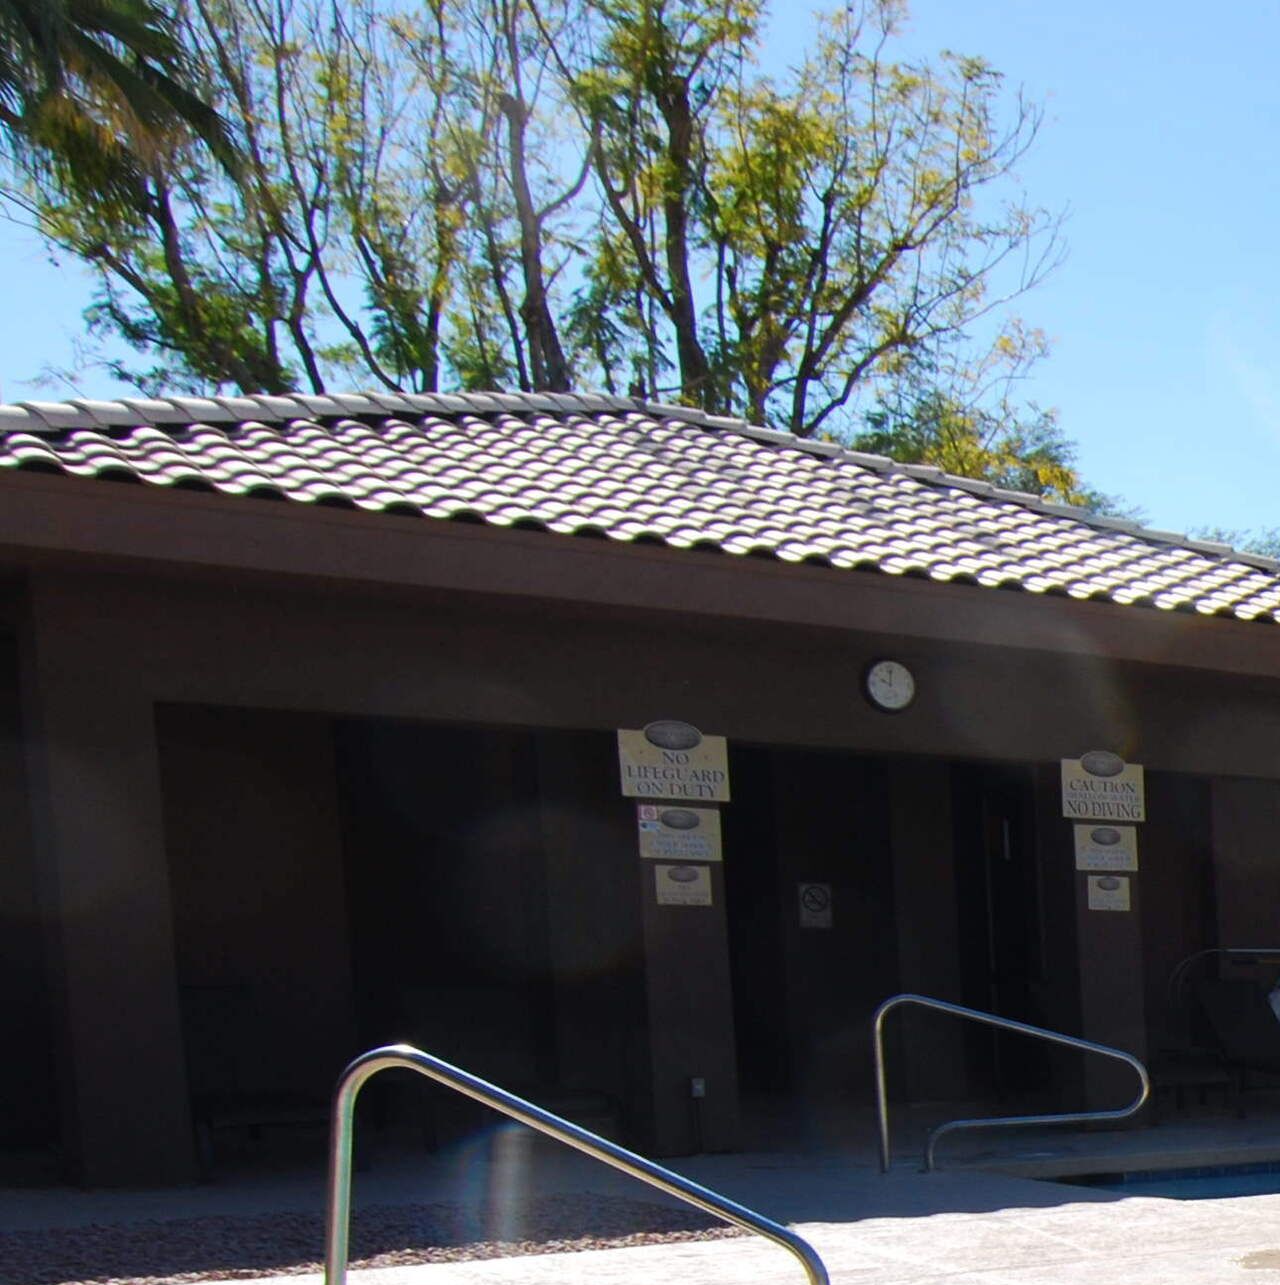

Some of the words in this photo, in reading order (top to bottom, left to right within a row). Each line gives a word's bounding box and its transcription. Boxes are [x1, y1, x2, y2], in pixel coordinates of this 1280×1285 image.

[663, 751, 690, 766] NO
[627, 765, 725, 783] LIFEGUARD
[637, 783, 664, 796] ON
[669, 784, 717, 798] DUTY
[1070, 779, 1136, 793] CAUTION
[1067, 801, 1089, 815] NO
[1092, 801, 1141, 818] DIVING
